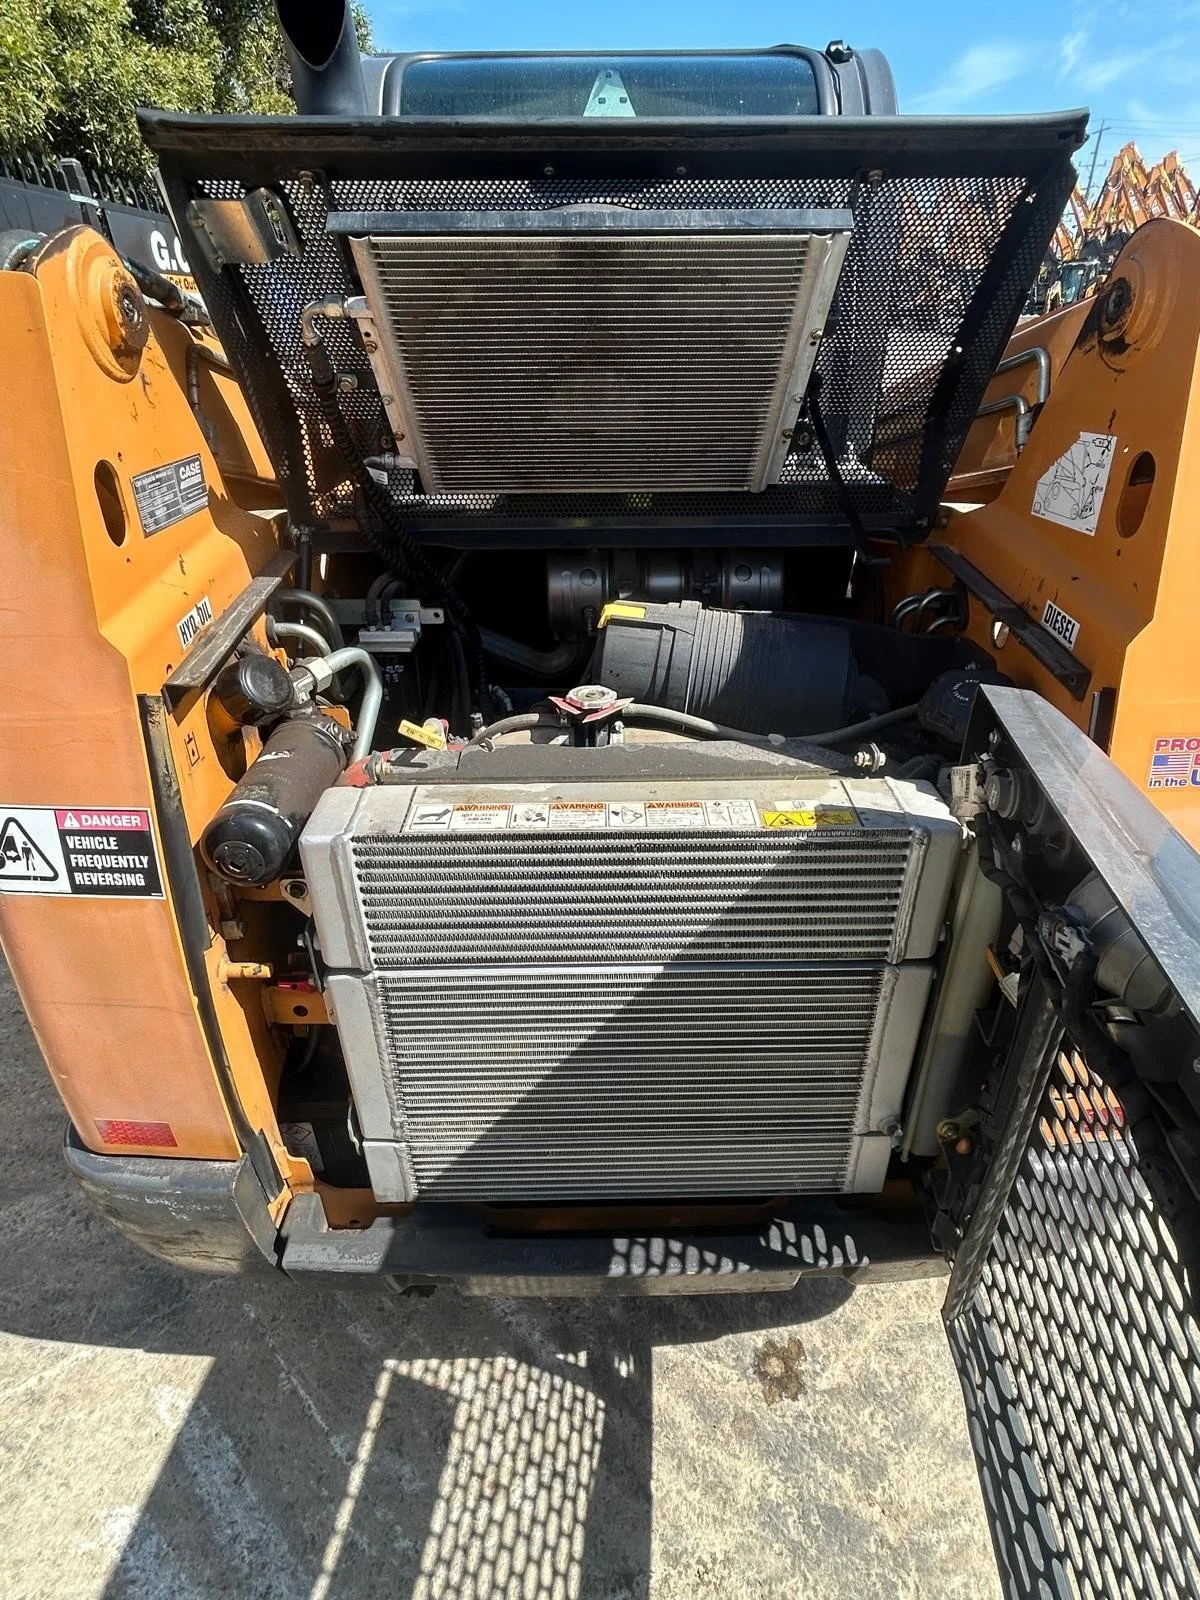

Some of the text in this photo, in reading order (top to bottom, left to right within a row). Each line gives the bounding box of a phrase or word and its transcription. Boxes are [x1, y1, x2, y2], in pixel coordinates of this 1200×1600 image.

[179, 460, 201, 480] CASE
[196, 600, 212, 626] OIL
[1043, 603, 1076, 646] DIESEL
[1148, 777, 1162, 787] in
[1164, 777, 1187, 787] the
[560, 802, 604, 810] WARNING
[81, 815, 142, 828] DANGER
[66, 836, 119, 850] VEHICLE
[70, 855, 149, 870] FREQUENTLY
[74, 872, 145, 887] REVERSING
